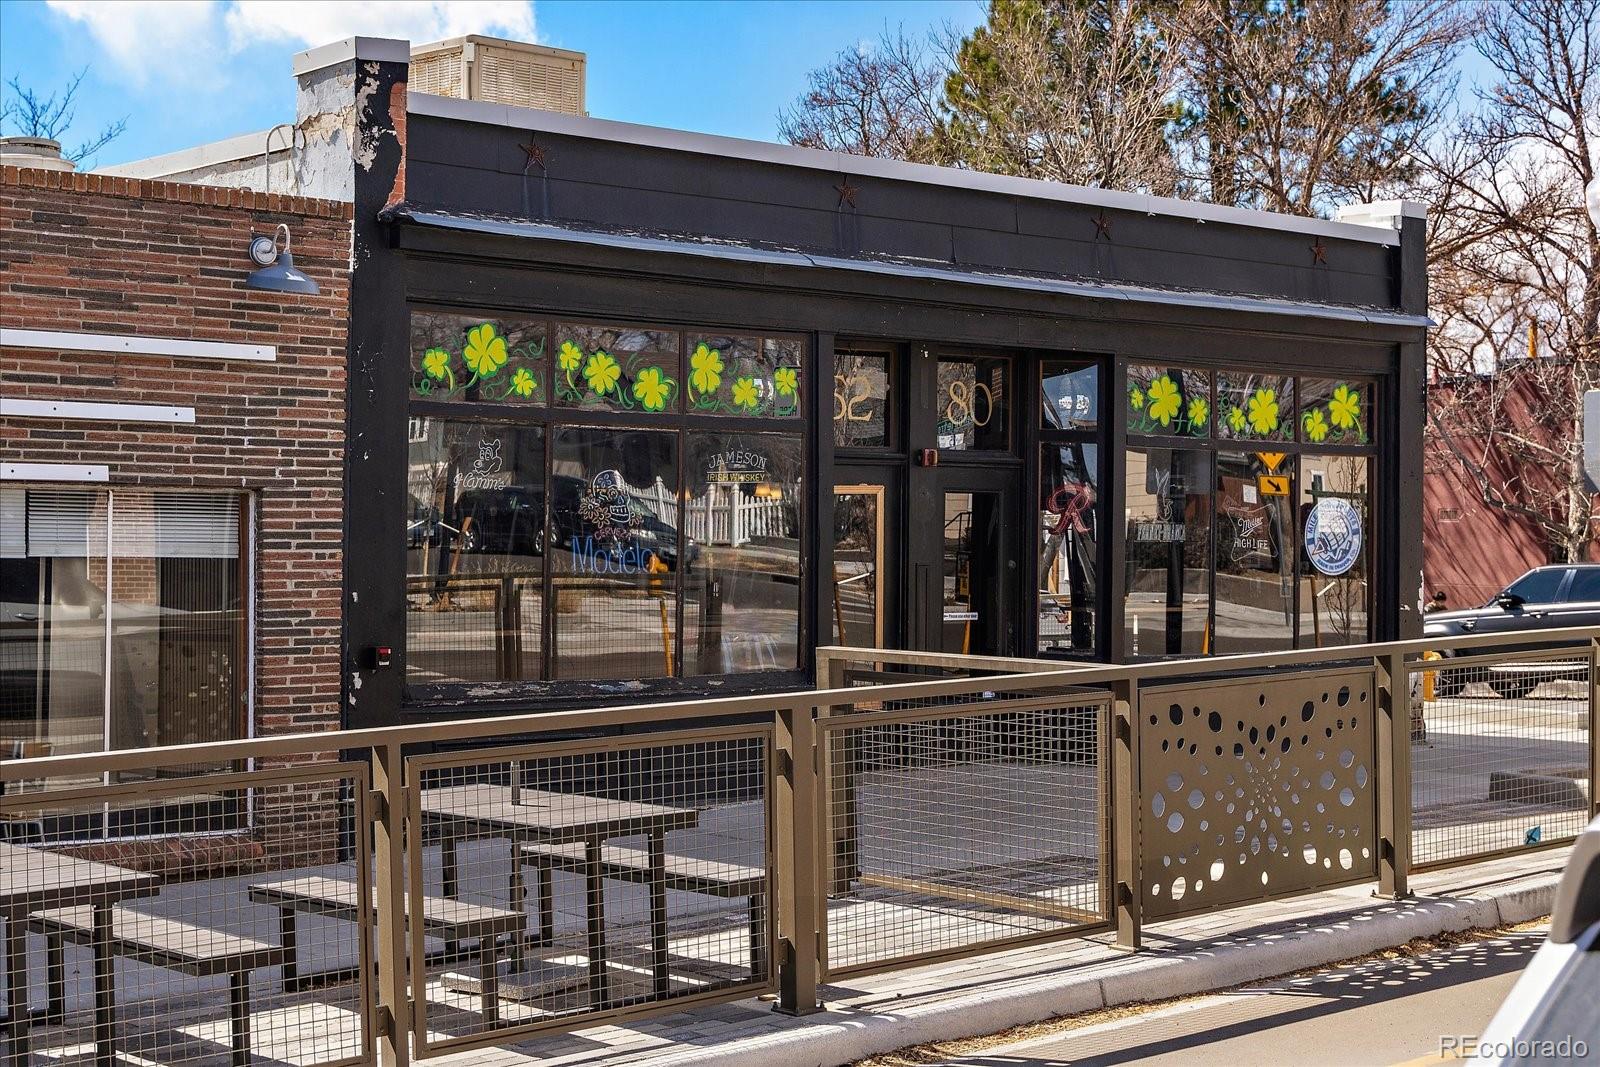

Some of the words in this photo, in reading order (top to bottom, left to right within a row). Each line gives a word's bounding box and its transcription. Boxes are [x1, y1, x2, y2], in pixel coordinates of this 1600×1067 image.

[948, 381, 993, 426] 80
[708, 450, 768, 470] JAMESON
[706, 472, 729, 482] IRISH
[729, 472, 766, 482] WHISKEY
[1237, 516, 1264, 536] Miller
[1233, 538, 1252, 549] HIGH
[1252, 538, 1269, 550] LIFE
[571, 535, 656, 575] Modelo
